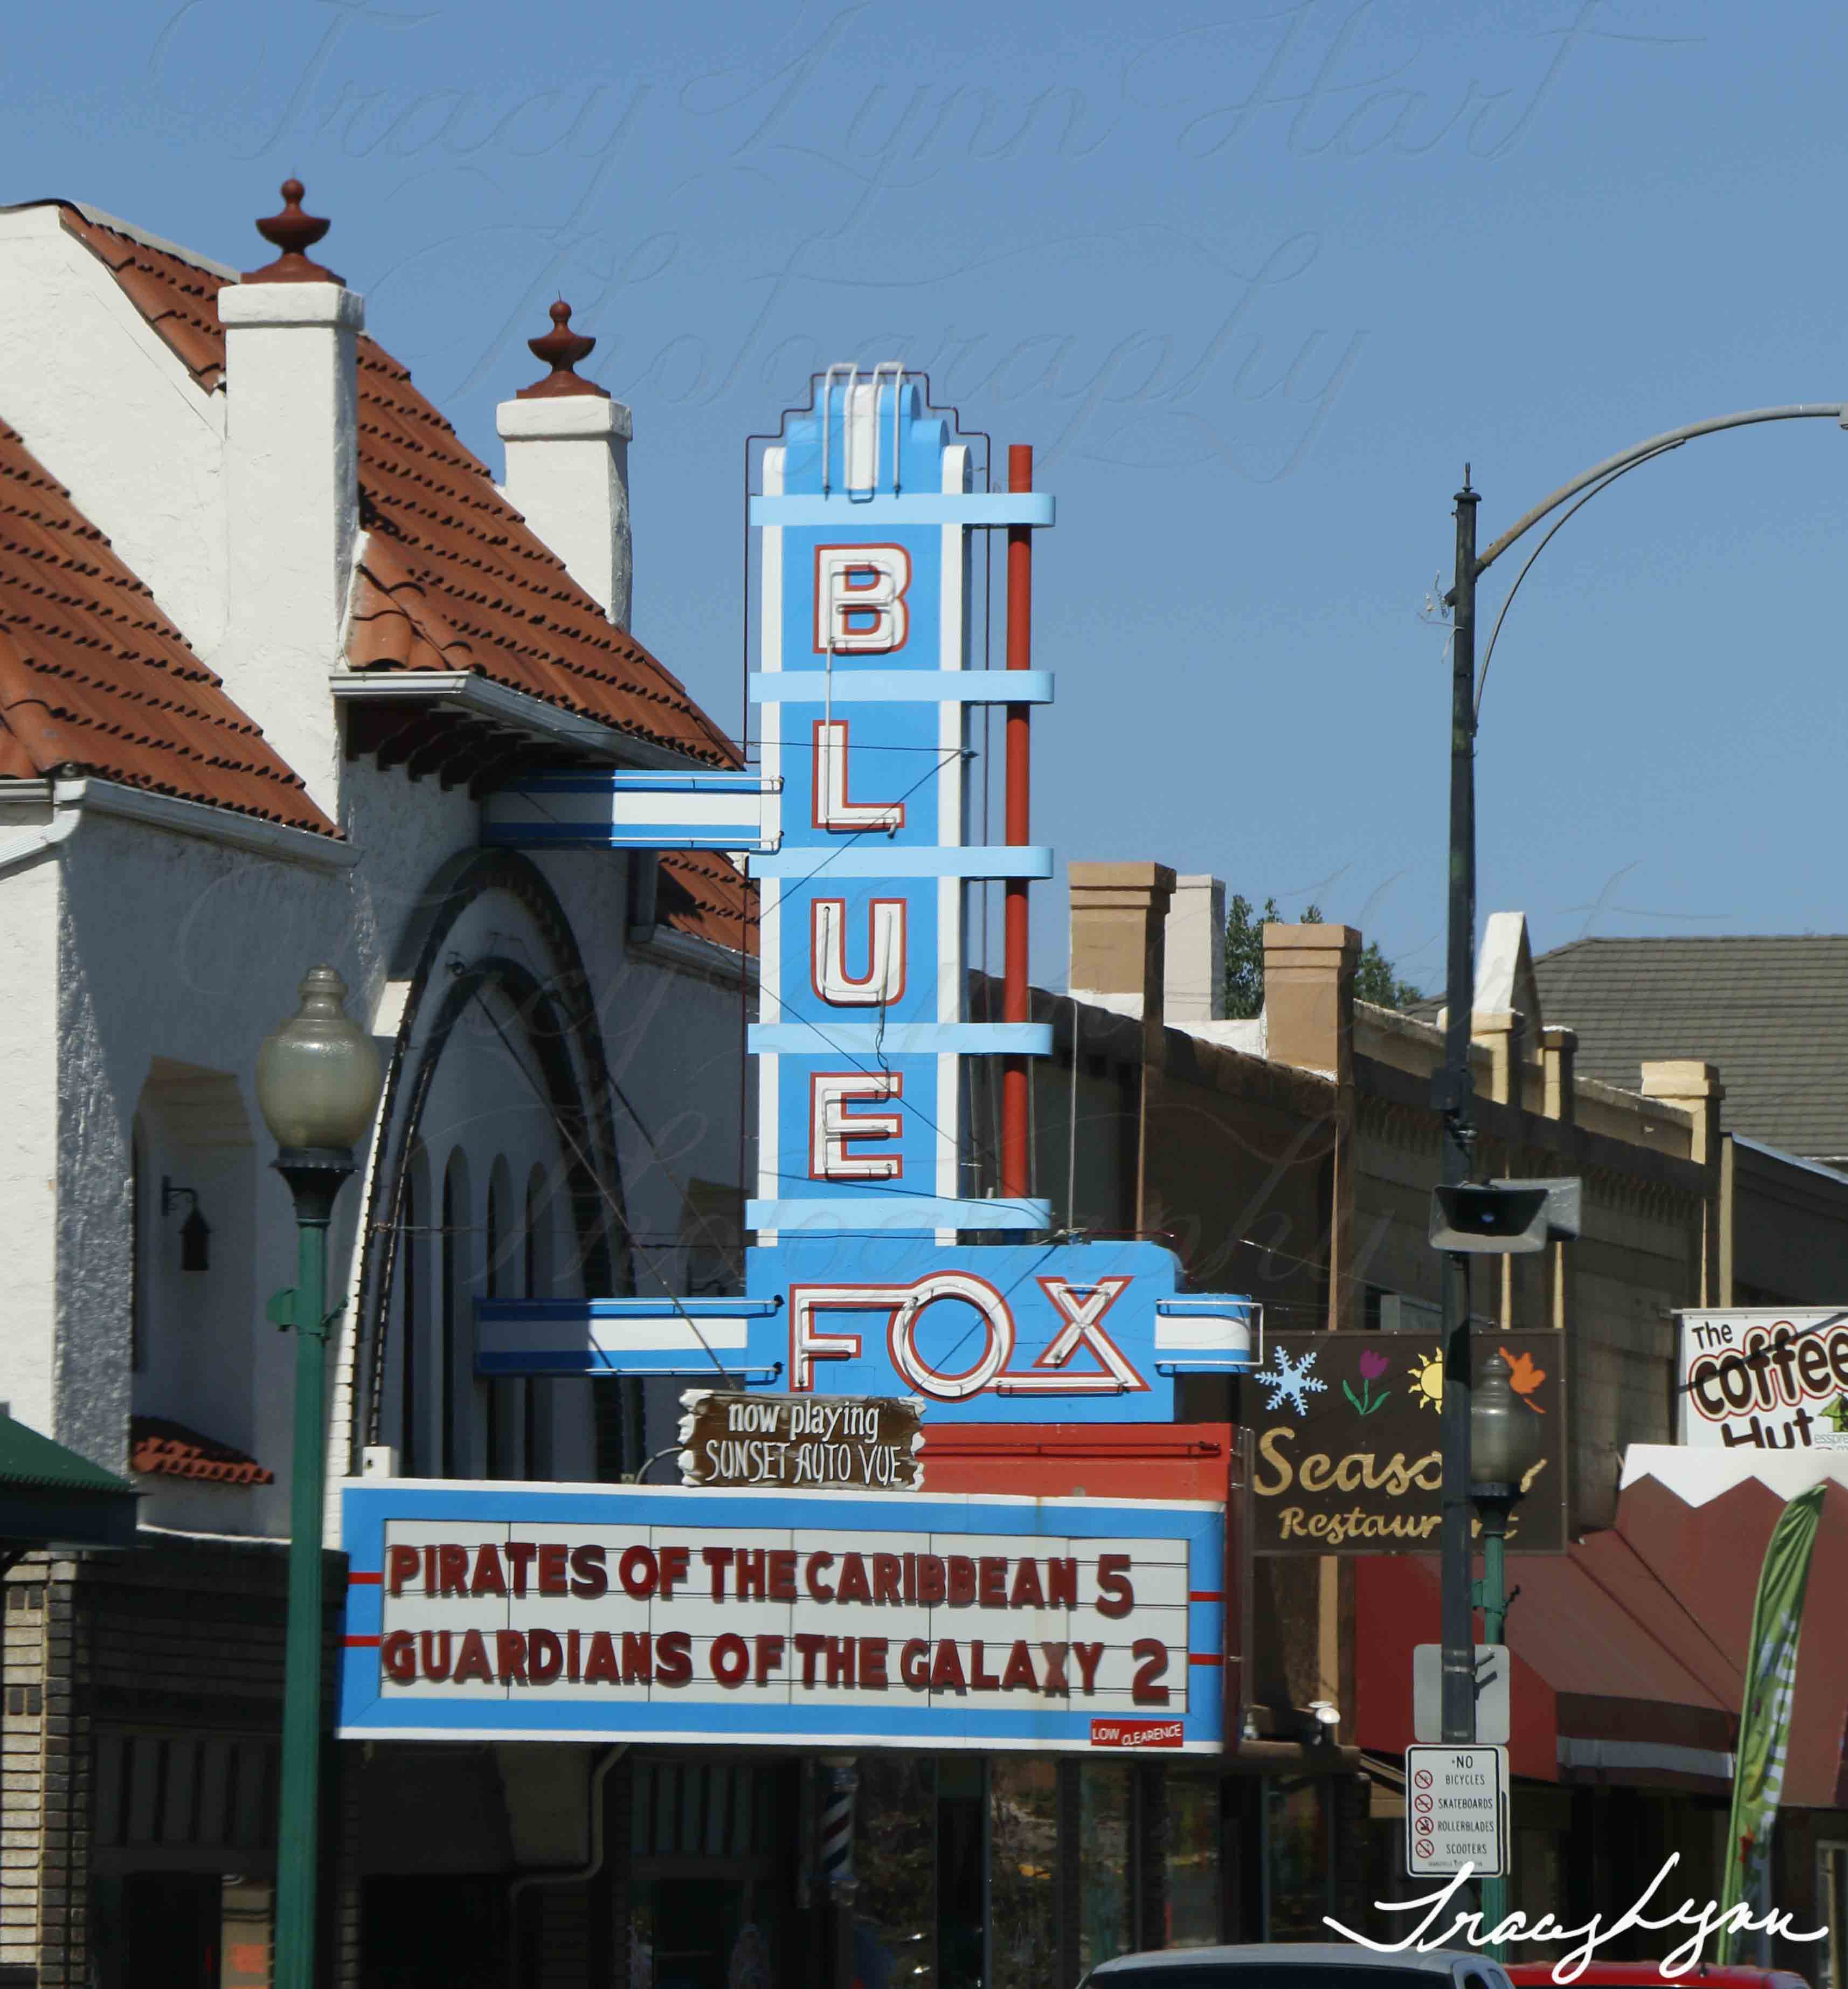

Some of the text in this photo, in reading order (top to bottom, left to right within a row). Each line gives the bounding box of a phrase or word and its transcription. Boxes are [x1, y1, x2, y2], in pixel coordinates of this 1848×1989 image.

[812, 542, 912, 1180] BLUE
[790, 1269, 1152, 1403] FOX
[1692, 1321, 1733, 1350] The
[729, 1399, 880, 1444] now playing
[1721, 1408, 1814, 1449] Hut
[705, 1439, 903, 1486] SUNSET AUTO VUE
[391, 1542, 1134, 1618] PIRATES OF THE CARIBBEAN 5
[382, 1629, 1170, 1705] GUARDIANS OF THE GALAXY 2
[1092, 1722, 1182, 1746] LOW CLEARENCE
[1456, 1755, 1473, 1769] NO
[1445, 1774, 1486, 1786] BICYCLES
[1438, 1798, 1493, 1810] SKATEBOARDS
[1437, 1820, 1494, 1832] ROLLERBLADES
[1445, 1843, 1487, 1855] SCOOTERS
